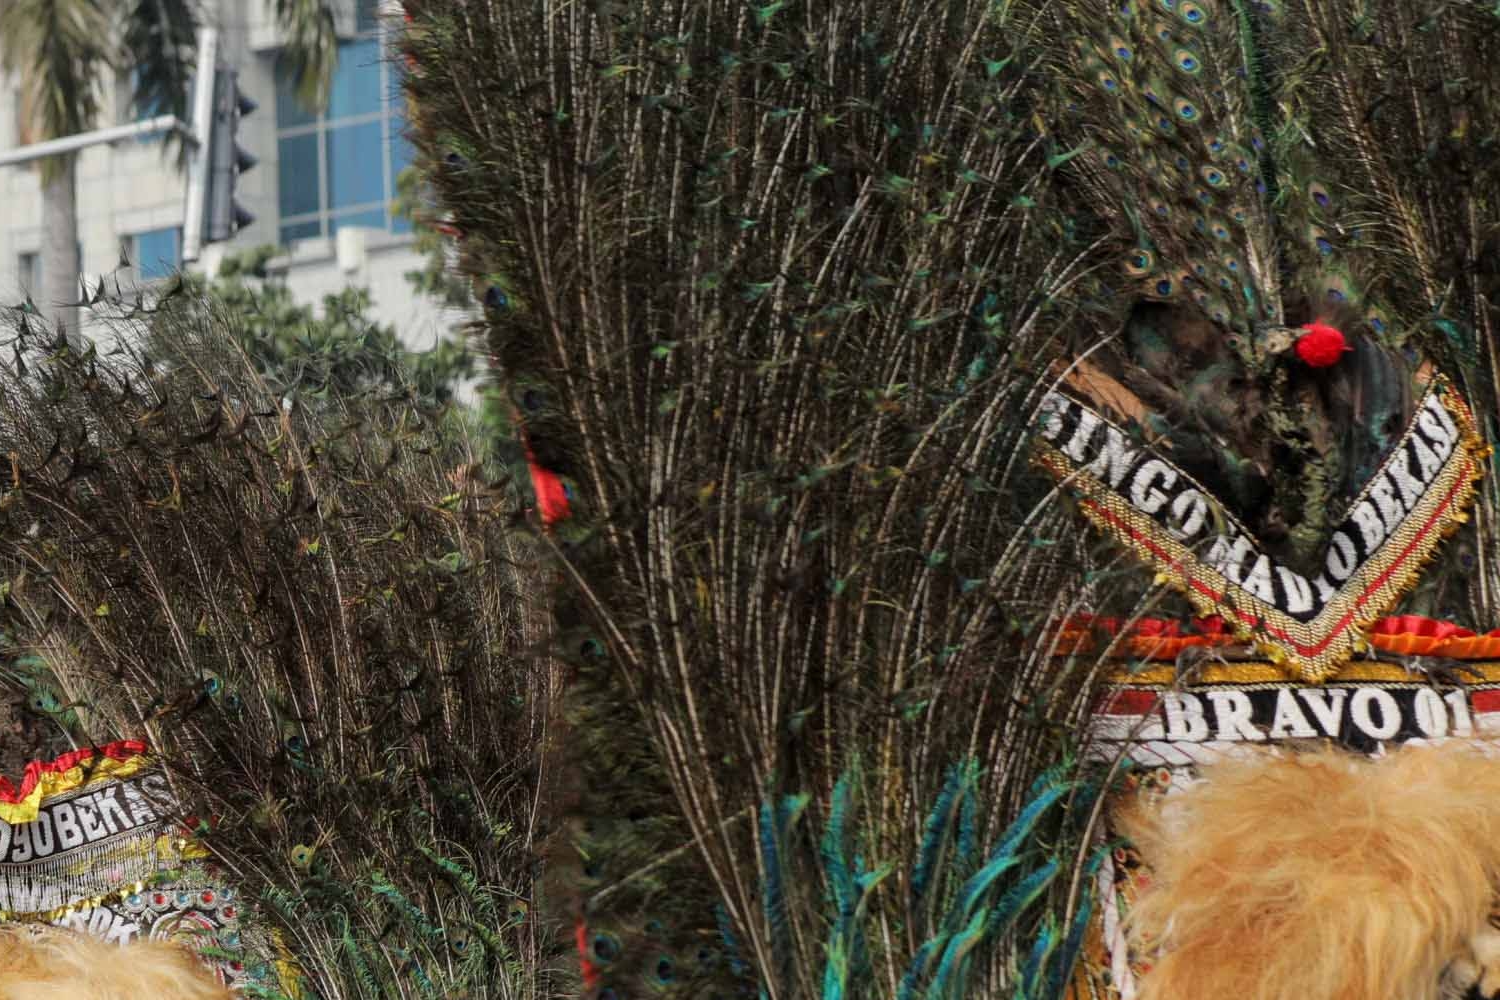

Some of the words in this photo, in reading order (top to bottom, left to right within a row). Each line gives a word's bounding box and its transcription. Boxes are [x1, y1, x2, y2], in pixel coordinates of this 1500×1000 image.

[1164, 688, 1401, 742] BRAVO
[1413, 687, 1472, 739] 01
[53, 775, 176, 850] BEKAS
